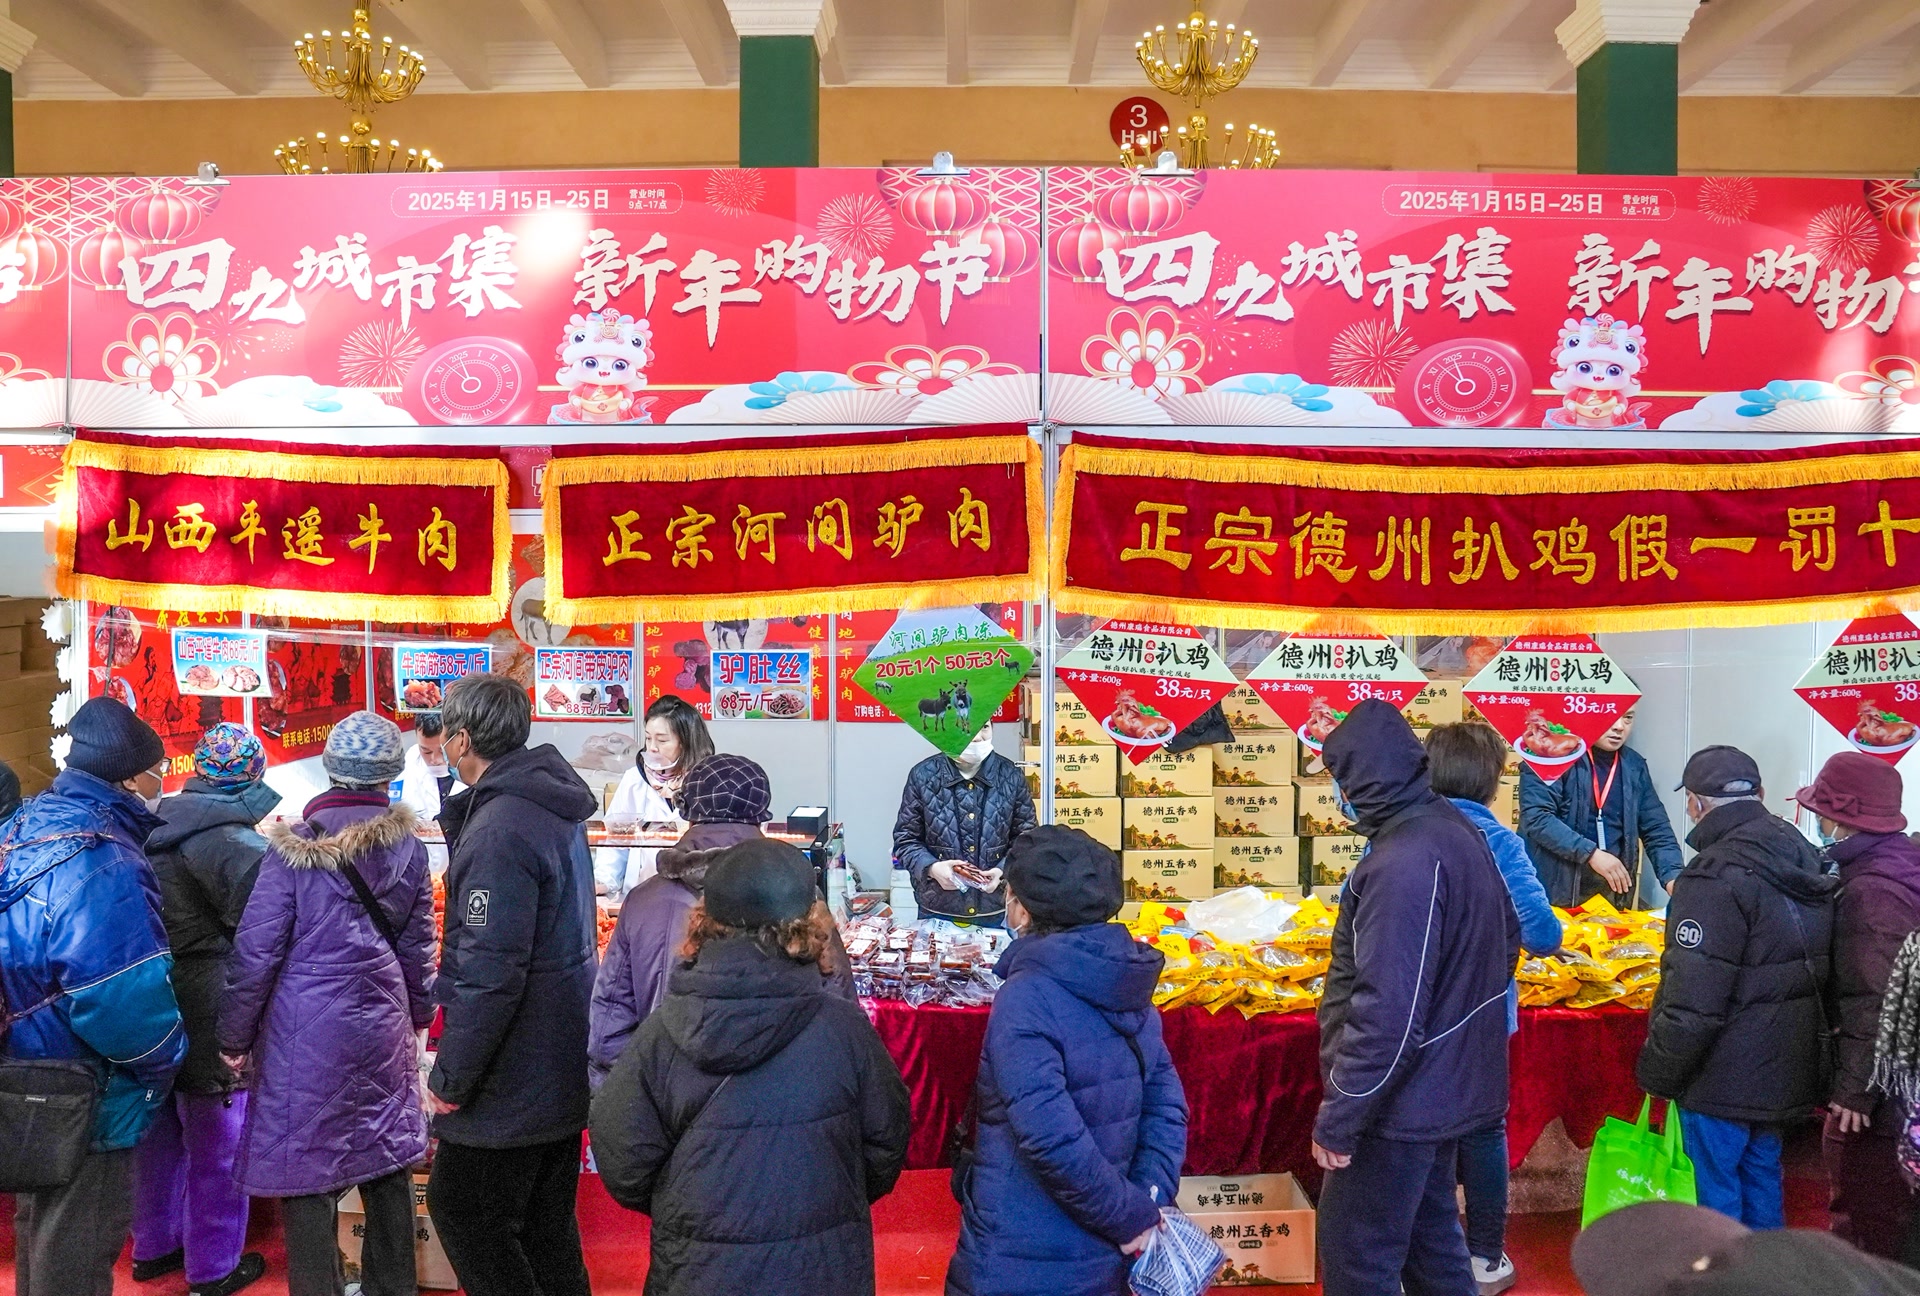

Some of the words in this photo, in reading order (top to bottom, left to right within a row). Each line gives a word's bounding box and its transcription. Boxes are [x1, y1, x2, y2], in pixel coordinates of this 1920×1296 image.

[1130, 104, 1148, 128] 3
[1121, 129, 1157, 145] Hall
[629, 189, 665, 199] 营业时间
[1622, 194, 1658, 205] 营业时间
[119, 225, 523, 331] 四九城市集
[573, 229, 992, 347] 新年购物节
[1097, 226, 1516, 332] 四九城市集
[1568, 233, 1920, 354] 新年购物
[106, 498, 458, 575] 山西平遥牛肉
[602, 487, 990, 569] 正宗河间驴肉
[1120, 500, 1920, 585] 正宗德州扒鸡假一罚十
[1004, 606, 1016, 621] 肉
[889, 620, 993, 648] 河间驴肉冻
[402, 651, 485, 677] 牛蹄筋58元/斤
[540, 651, 630, 682] 正宗河间带皮驴肉
[646, 626, 663, 699] 地下驴肉
[719, 654, 802, 685] 驴肚丝
[838, 628, 855, 701] 地下驴肉
[876, 655, 940, 678] 20元1个
[945, 648, 1010, 670] 50元3个
[1824, 647, 1920, 676] 德州扒
[1068, 671, 1122, 686] 净含量:600g
[1260, 682, 1314, 694] 净含量:600g
[1155, 678, 1211, 700] 38元/只
[1347, 682, 1403, 702] 38元/只
[1809, 689, 1861, 699] 净含量:600g
[1894, 683, 1920, 702] 38
[720, 693, 774, 711] 68元/斤
[1477, 695, 1530, 706] 净含量:600g
[1563, 695, 1617, 714] 38元/只
[1223, 744, 1276, 754] 德州五香鸡
[1225, 795, 1278, 805] 德州五香鸡
[1143, 806, 1197, 817] 德州五香鸡
[1230, 845, 1283, 856] 德州五香鸡
[1142, 858, 1197, 869] 德州五香鸡
[1679, 925, 1699, 944] 90
[1209, 1223, 1290, 1239] 德州五香鸡
